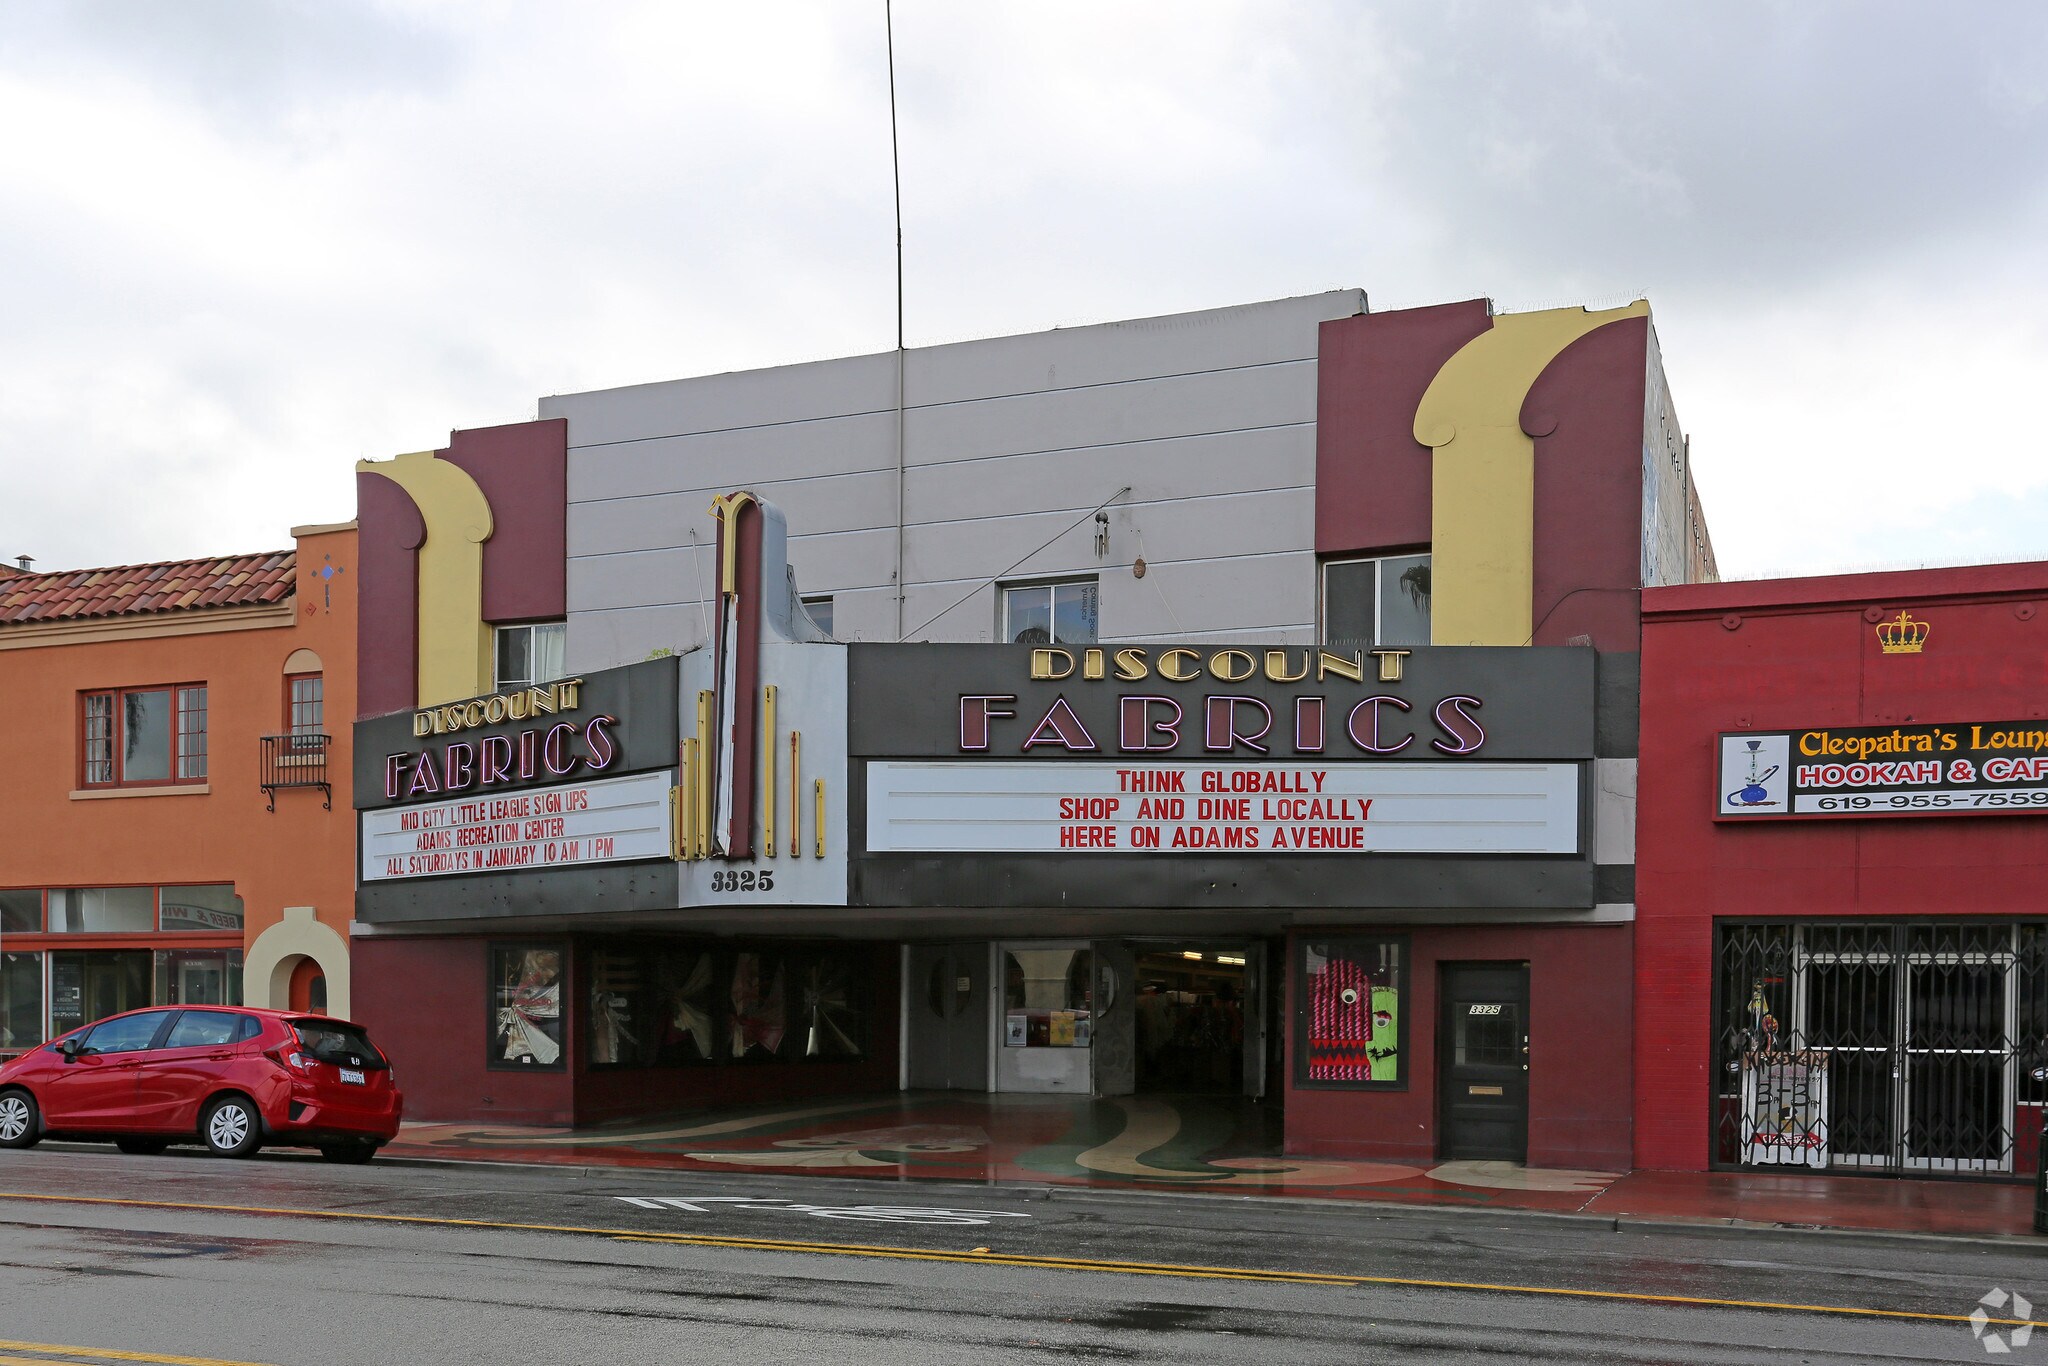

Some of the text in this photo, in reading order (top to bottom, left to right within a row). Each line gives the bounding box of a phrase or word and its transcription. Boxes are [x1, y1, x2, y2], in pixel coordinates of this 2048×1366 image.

[1030, 647, 1413, 683] DISCOUNT
[413, 678, 583, 737] DISCOUNT
[957, 693, 1486, 755] FABRICS
[384, 714, 618, 799] FABRICS
[1799, 725, 2048, 760] Cleopatra's Loun
[1116, 770, 1327, 793] THINK GLOBALLY
[1798, 762, 1941, 787] HOOKAH
[1948, 760, 1975, 782] &
[401, 789, 588, 831] MID CITY LITTLE LEAGUE SIGN UPS
[1059, 797, 1374, 820] SHOP AND DINE LOCALLY
[1818, 791, 2048, 810] 619-955-7559
[416, 817, 564, 851] ADAMS RECREATION CENTER
[1060, 826, 1364, 848] HERE ON ADAMS AVENUE
[386, 858, 405, 876] ALL
[409, 851, 468, 874] SATURDAYS
[472, 850, 483, 868] IN
[485, 845, 537, 867] JANUARY
[543, 842, 557, 862] 10
[560, 841, 579, 860] AM
[595, 838, 614, 857] PM
[711, 870, 774, 892] 3325
[1471, 1005, 1500, 1014] 3325
